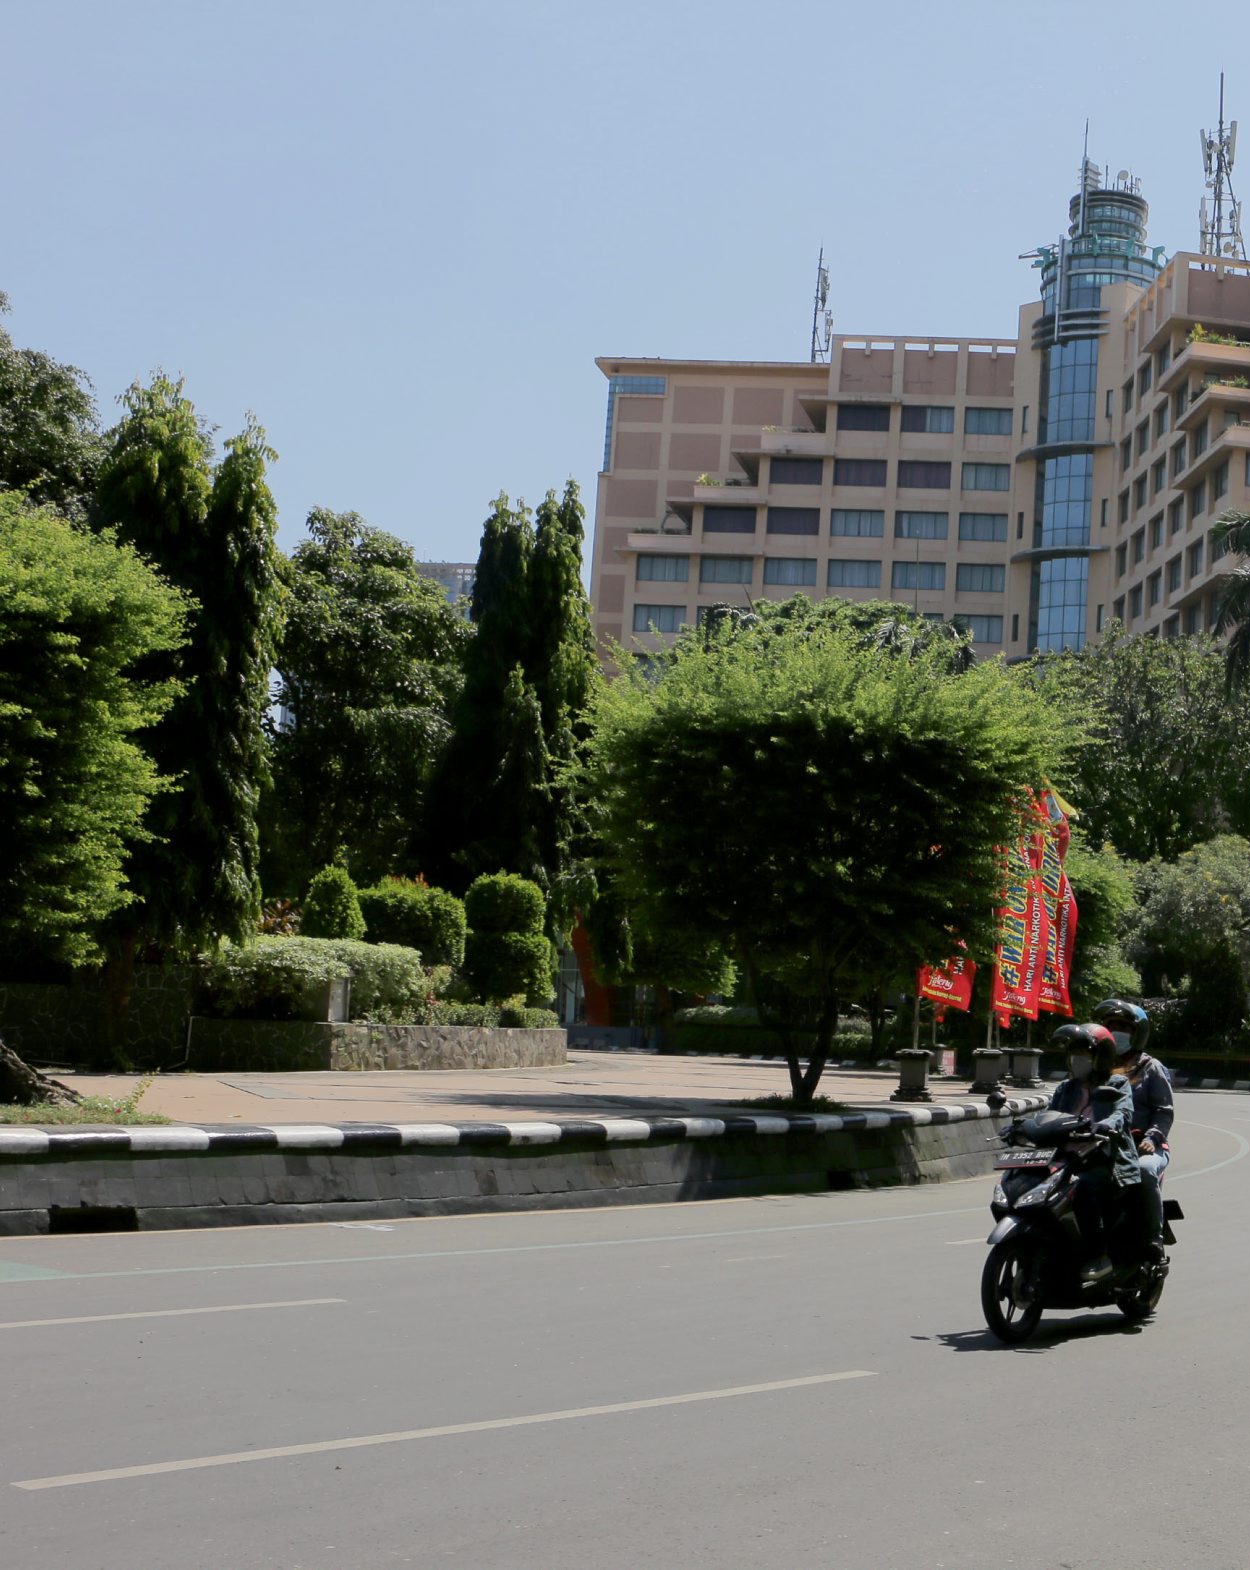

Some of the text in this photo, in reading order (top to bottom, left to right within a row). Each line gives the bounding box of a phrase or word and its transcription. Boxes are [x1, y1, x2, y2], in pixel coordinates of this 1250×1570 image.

[1023, 891, 1041, 992] HARI ANTI NARKOTIK
